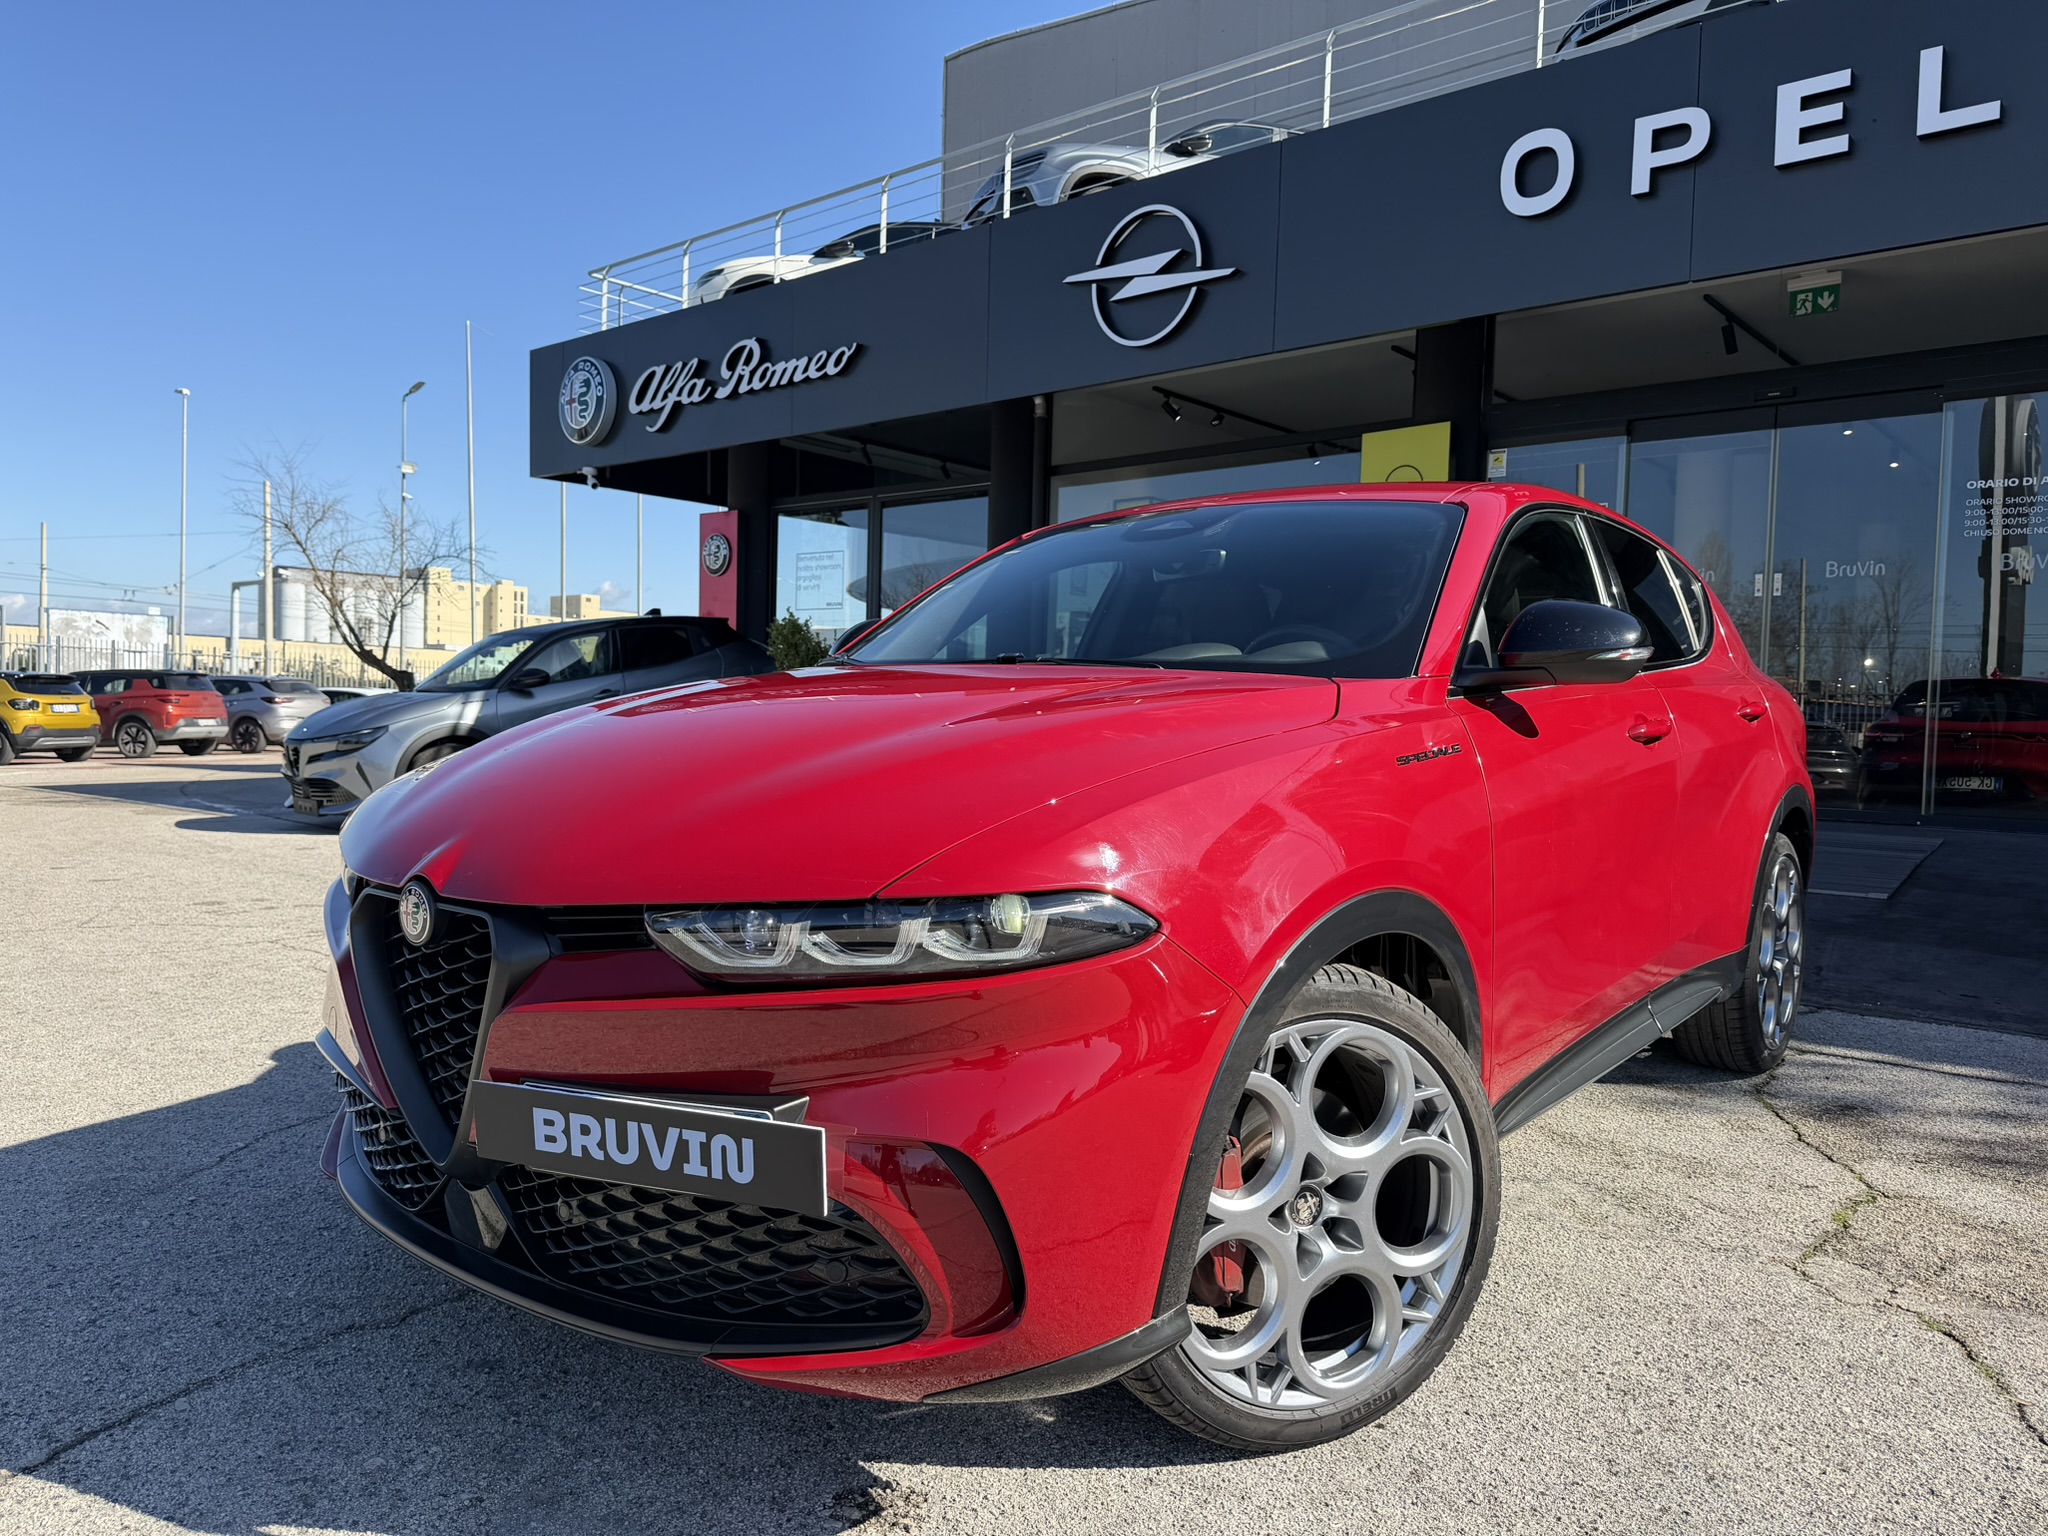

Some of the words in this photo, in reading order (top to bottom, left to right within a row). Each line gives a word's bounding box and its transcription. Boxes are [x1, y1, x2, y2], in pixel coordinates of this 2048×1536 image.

[1499, 45, 2002, 218] OPEL
[578, 362, 603, 396] ROMEO
[628, 357, 712, 432] Alfa
[714, 337, 857, 399] Romeo
[1966, 478, 2019, 489] ORARIO
[2022, 477, 2037, 486] DI
[1966, 497, 2003, 506] ORARIO
[1963, 529, 2000, 537] CHIUSO
[1826, 560, 1886, 578] BruVin
[1396, 743, 1462, 767] SPECIALE
[533, 1107, 755, 1184] BRUVIN
[1340, 1386, 1398, 1429] PIRELLI
